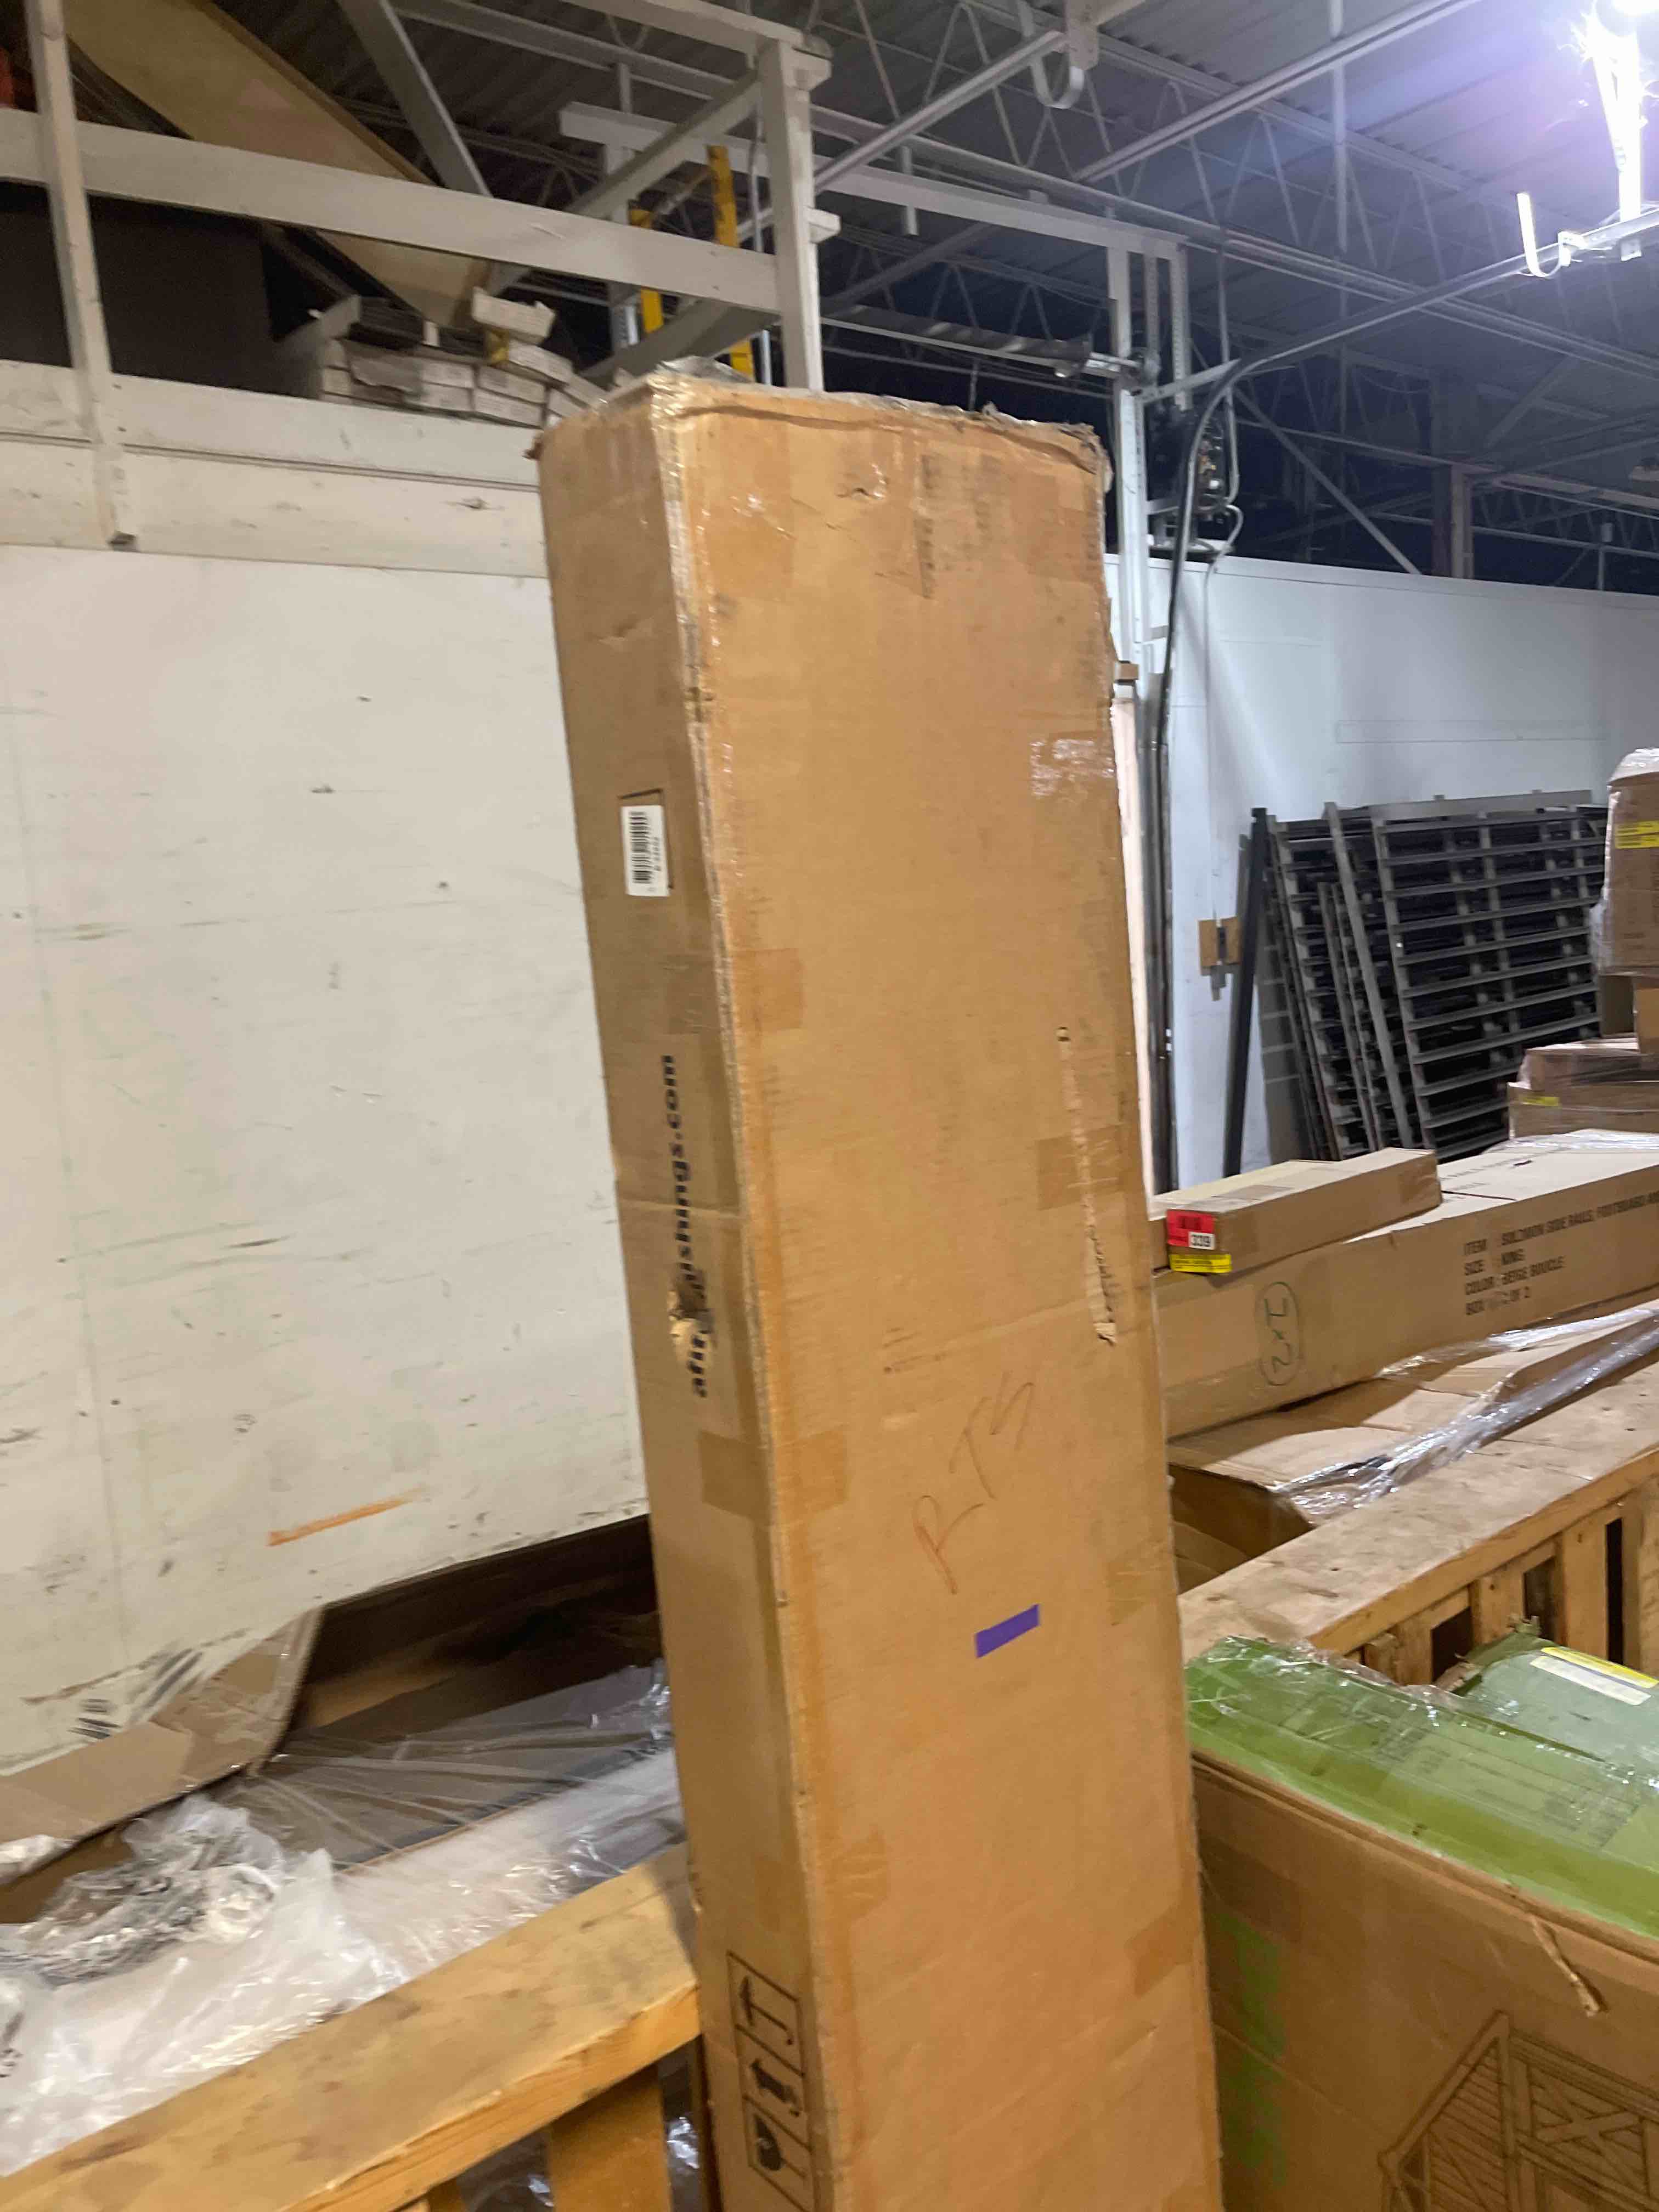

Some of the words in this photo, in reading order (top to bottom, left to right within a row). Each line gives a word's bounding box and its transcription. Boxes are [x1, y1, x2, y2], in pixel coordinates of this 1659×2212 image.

[1464, 1238, 1487, 1256] ITEM
[1545, 1216, 1567, 1234] SIDE
[1464, 1259, 1485, 1276] SIZE
[1465, 1276, 1494, 1296] COLOR
[1502, 1266, 1528, 1285] BEIGE
